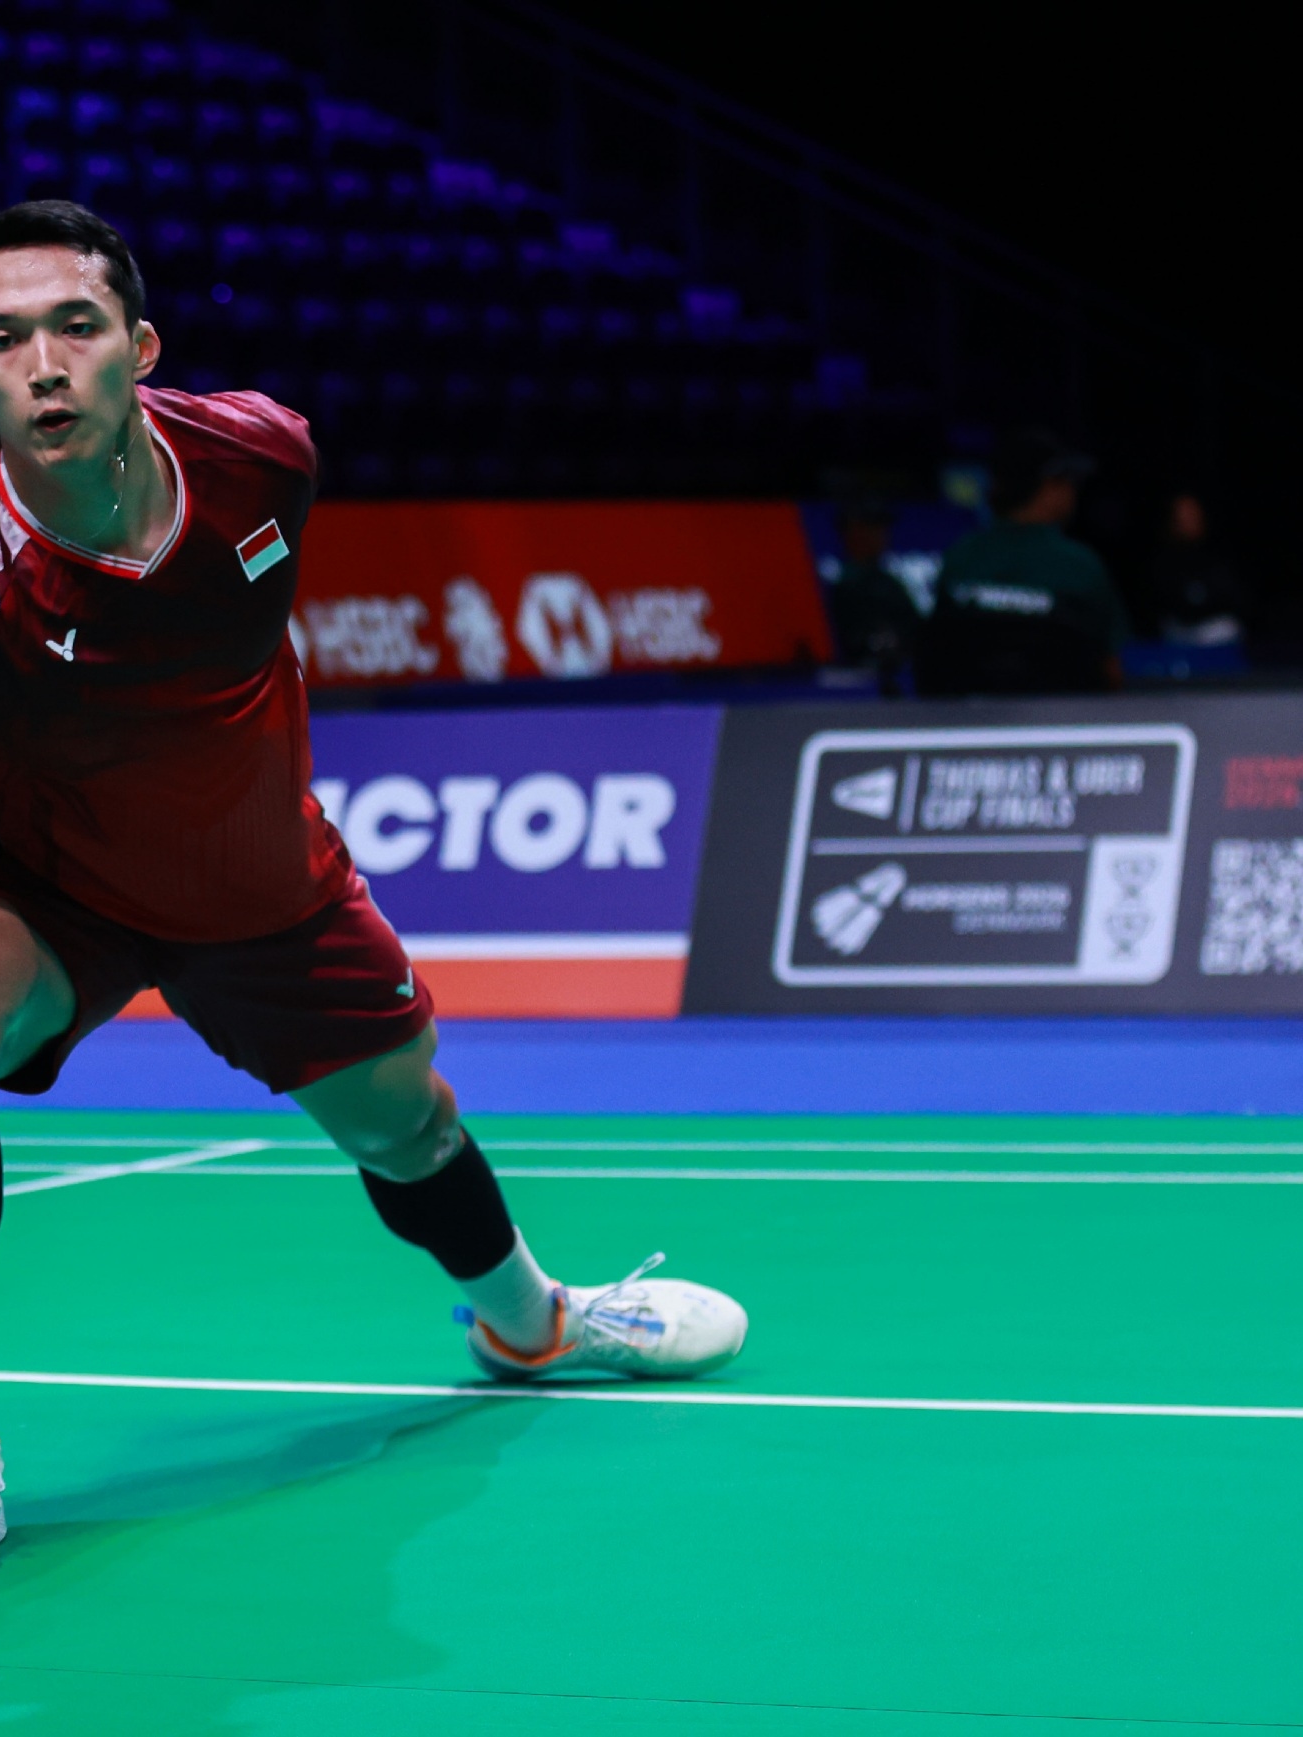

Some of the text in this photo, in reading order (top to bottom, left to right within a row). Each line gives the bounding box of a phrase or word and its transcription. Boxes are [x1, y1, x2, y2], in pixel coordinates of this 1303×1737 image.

[306, 597, 438, 674] HSBC
[928, 757, 1041, 796] THOMAS
[922, 794, 1075, 830] CUP FINALS
